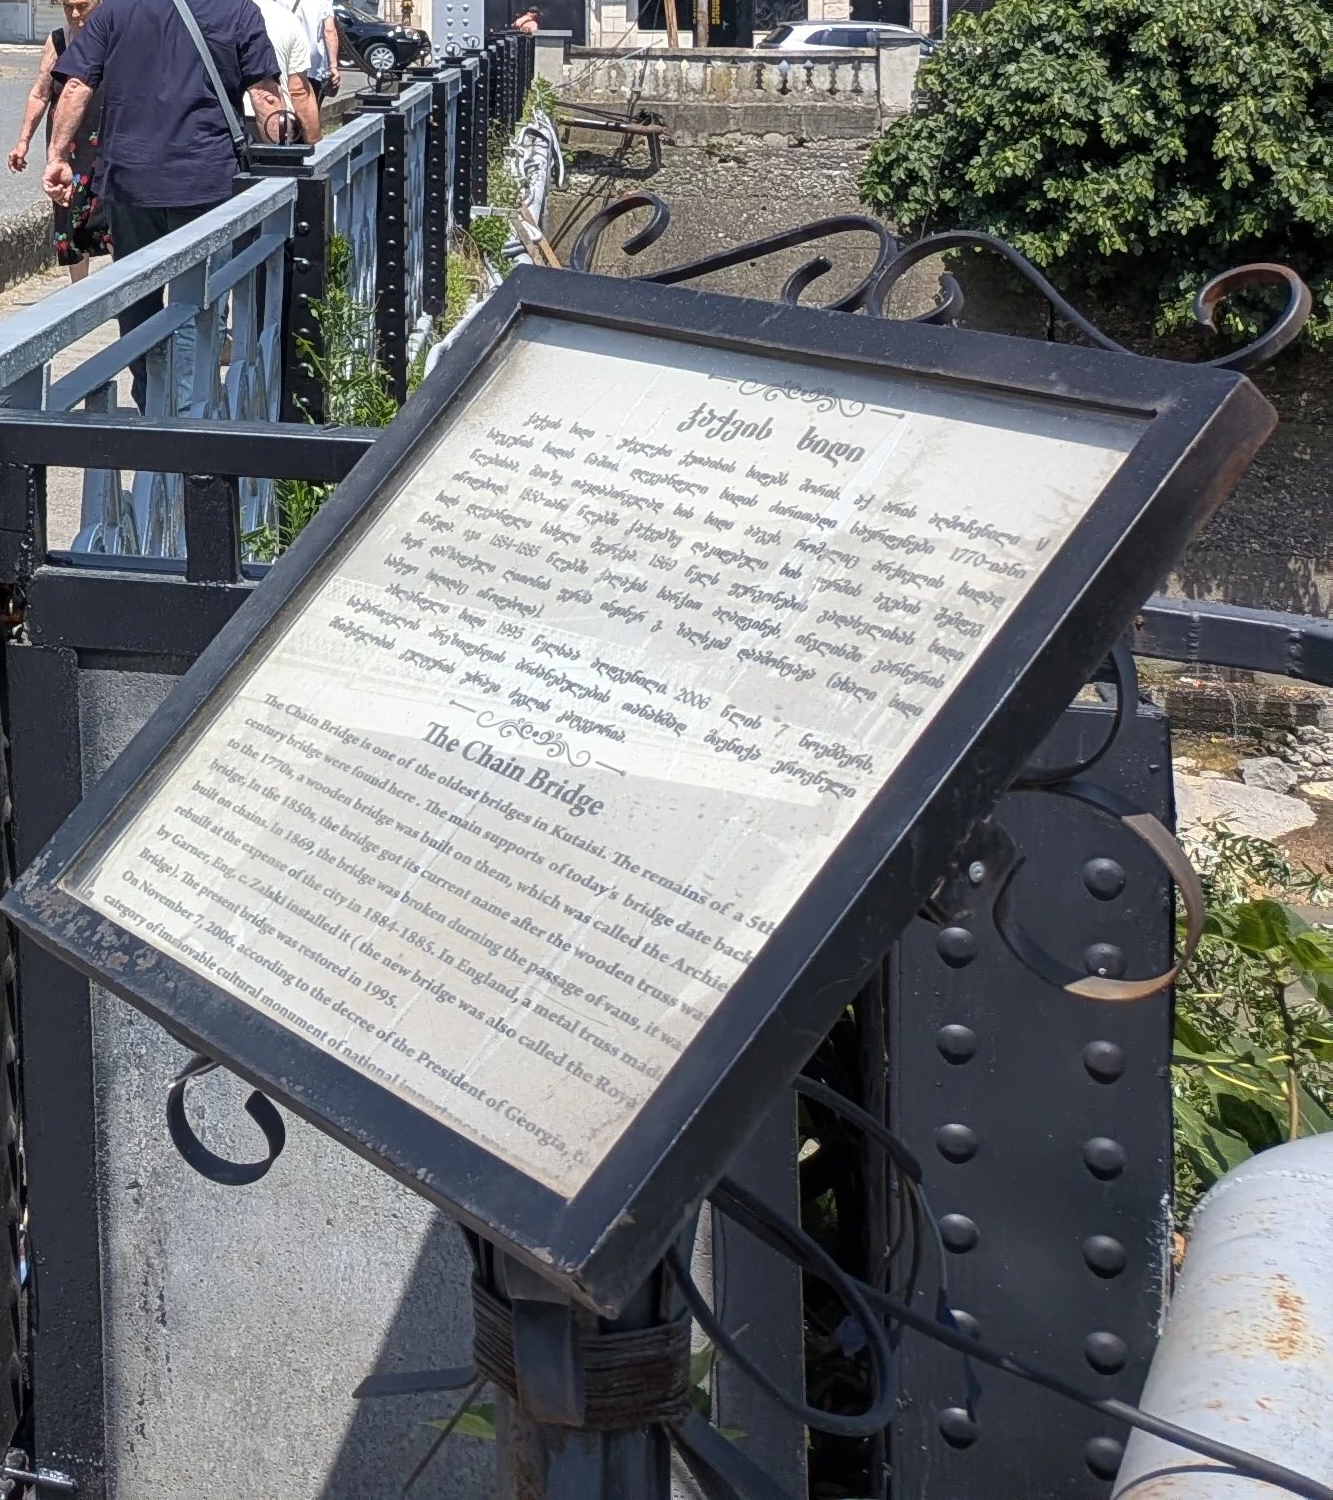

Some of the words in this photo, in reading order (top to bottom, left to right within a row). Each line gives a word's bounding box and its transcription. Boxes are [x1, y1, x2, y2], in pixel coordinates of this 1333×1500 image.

[420, 721, 461, 753] The
[461, 740, 526, 783] Chain
[523, 766, 605, 818] Bridge
[495, 620, 527, 640] 1995
[672, 683, 713, 711] 2006
[191, 779, 220, 801] built
[216, 796, 233, 810] on
[231, 803, 268, 829] chains.
[269, 821, 284, 837] In
[283, 829, 316, 856] 1869,
[315, 847, 337, 865] the
[335, 856, 377, 886] bridge
[376, 880, 401, 899] was
[399, 890, 447, 924] broken
[446, 917, 504, 957] durning
[502, 946, 528, 967] the
[522, 961, 584, 997] passage
[584, 992, 609, 1008] of
[603, 1001, 641, 1032] vans,
[642, 1021, 660, 1038] it
[660, 1031, 682, 1052] wa
[226, 737, 241, 750] to
[239, 743, 260, 762] the
[259, 753, 295, 780] 1770s,
[295, 773, 306, 783] a
[305, 776, 354, 807] wooden
[351, 797, 395, 826] bridge
[394, 820, 421, 839] was
[419, 830, 455, 856] built
[452, 851, 473, 866] on
[473, 858, 513, 889] them,
[516, 880, 562, 910] which
[562, 903, 593, 925] was
[592, 919, 645, 950] called
[640, 942, 670, 964] the
[668, 957, 729, 993] Archie
[244, 717, 288, 744] century
[285, 733, 323, 760] bridge
[323, 753, 352, 773] were
[350, 765, 392, 790] found
[386, 781, 417, 804] here
[423, 798, 449, 819] The
[446, 813, 483, 836] main
[481, 830, 546, 865] supports
[547, 861, 571, 876] of
[564, 867, 620, 901] today's
[622, 892, 676, 928] bridge
[674, 920, 712, 946] date
[246, 777, 262, 793] In
[260, 786, 281, 802] the
[280, 795, 317, 824] 1850s,
[318, 815, 340, 833] the
[338, 824, 381, 853] bridge
[376, 848, 404, 865] got
[401, 857, 421, 874] its
[419, 863, 472, 900] current
[468, 895, 511, 921] name
[509, 916, 548, 938] after
[545, 932, 573, 953] the
[573, 942, 635, 986] wooden
[635, 978, 679, 1008] truss
[258, 692, 285, 710] The
[284, 703, 320, 727] Chain
[318, 718, 361, 745] Bridge
[358, 737, 373, 751] is
[371, 746, 397, 762] one
[396, 757, 417, 769] of
[413, 763, 438, 780] the
[436, 775, 481, 800] oldest
[473, 790, 533, 824] bridges
[530, 815, 549, 833] in
[548, 823, 607, 860] Kutaisi.
[610, 850, 641, 874] The
[640, 868, 714, 905] remains
[708, 900, 736, 916] of
[732, 911, 745, 923] a
[103, 894, 148, 927] category
[145, 921, 164, 934] of
[215, 966, 265, 1000] cultural
[259, 994, 329, 1043] monument
[326, 1037, 349, 1053] of
[340, 1046, 401, 1085] national
[121, 869, 140, 888] On
[137, 879, 195, 920] November
[193, 913, 206, 930] 7,
[236, 943, 297, 987] according
[294, 977, 310, 992] to
[309, 986, 332, 1006] the
[330, 999, 376, 1033] decree
[374, 1029, 398, 1044] of
[391, 1036, 416, 1058] the
[413, 1049, 487, 1102] President
[485, 1097, 510, 1113] of
[504, 1105, 569, 1158] Georgia,
[138, 846, 180, 879] Bridge).
[179, 870, 201, 890] The
[195, 885, 241, 915] present
[238, 905, 277, 936] bridge
[276, 930, 299, 949] was
[297, 944, 352, 979] restored
[346, 970, 363, 988] in
[362, 980, 398, 1010] 1995.
[155, 823, 173, 841] by
[171, 833, 211, 865] Garner,
[209, 855, 236, 880] Eng.
[237, 874, 248, 885] c.
[248, 877, 289, 907] Zalski
[284, 898, 342, 937] installed
[336, 928, 352, 943] it
[358, 941, 382, 961] the
[379, 956, 413, 977] new
[410, 968, 457, 1004] bridge
[457, 999, 486, 1021] was
[484, 1016, 518, 1039] also
[517, 1035, 569, 1067] called
[564, 1060, 594, 1083] the
[592, 1074, 639, 1111] Roya
[173, 805, 213, 830] rebuilt
[209, 825, 225, 837] at
[221, 830, 242, 847] the
[240, 842, 289, 872] expense
[287, 868, 307, 881] of
[300, 874, 323, 892] the
[322, 887, 349, 907] city
[345, 897, 362, 914] in
[362, 907, 436, 956] 1884-1885.
[436, 947, 455, 966] In
[453, 957, 521, 1004] England,
[518, 997, 533, 1009] a
[531, 1003, 582, 1034] metal
[577, 1025, 621, 1057] truss
